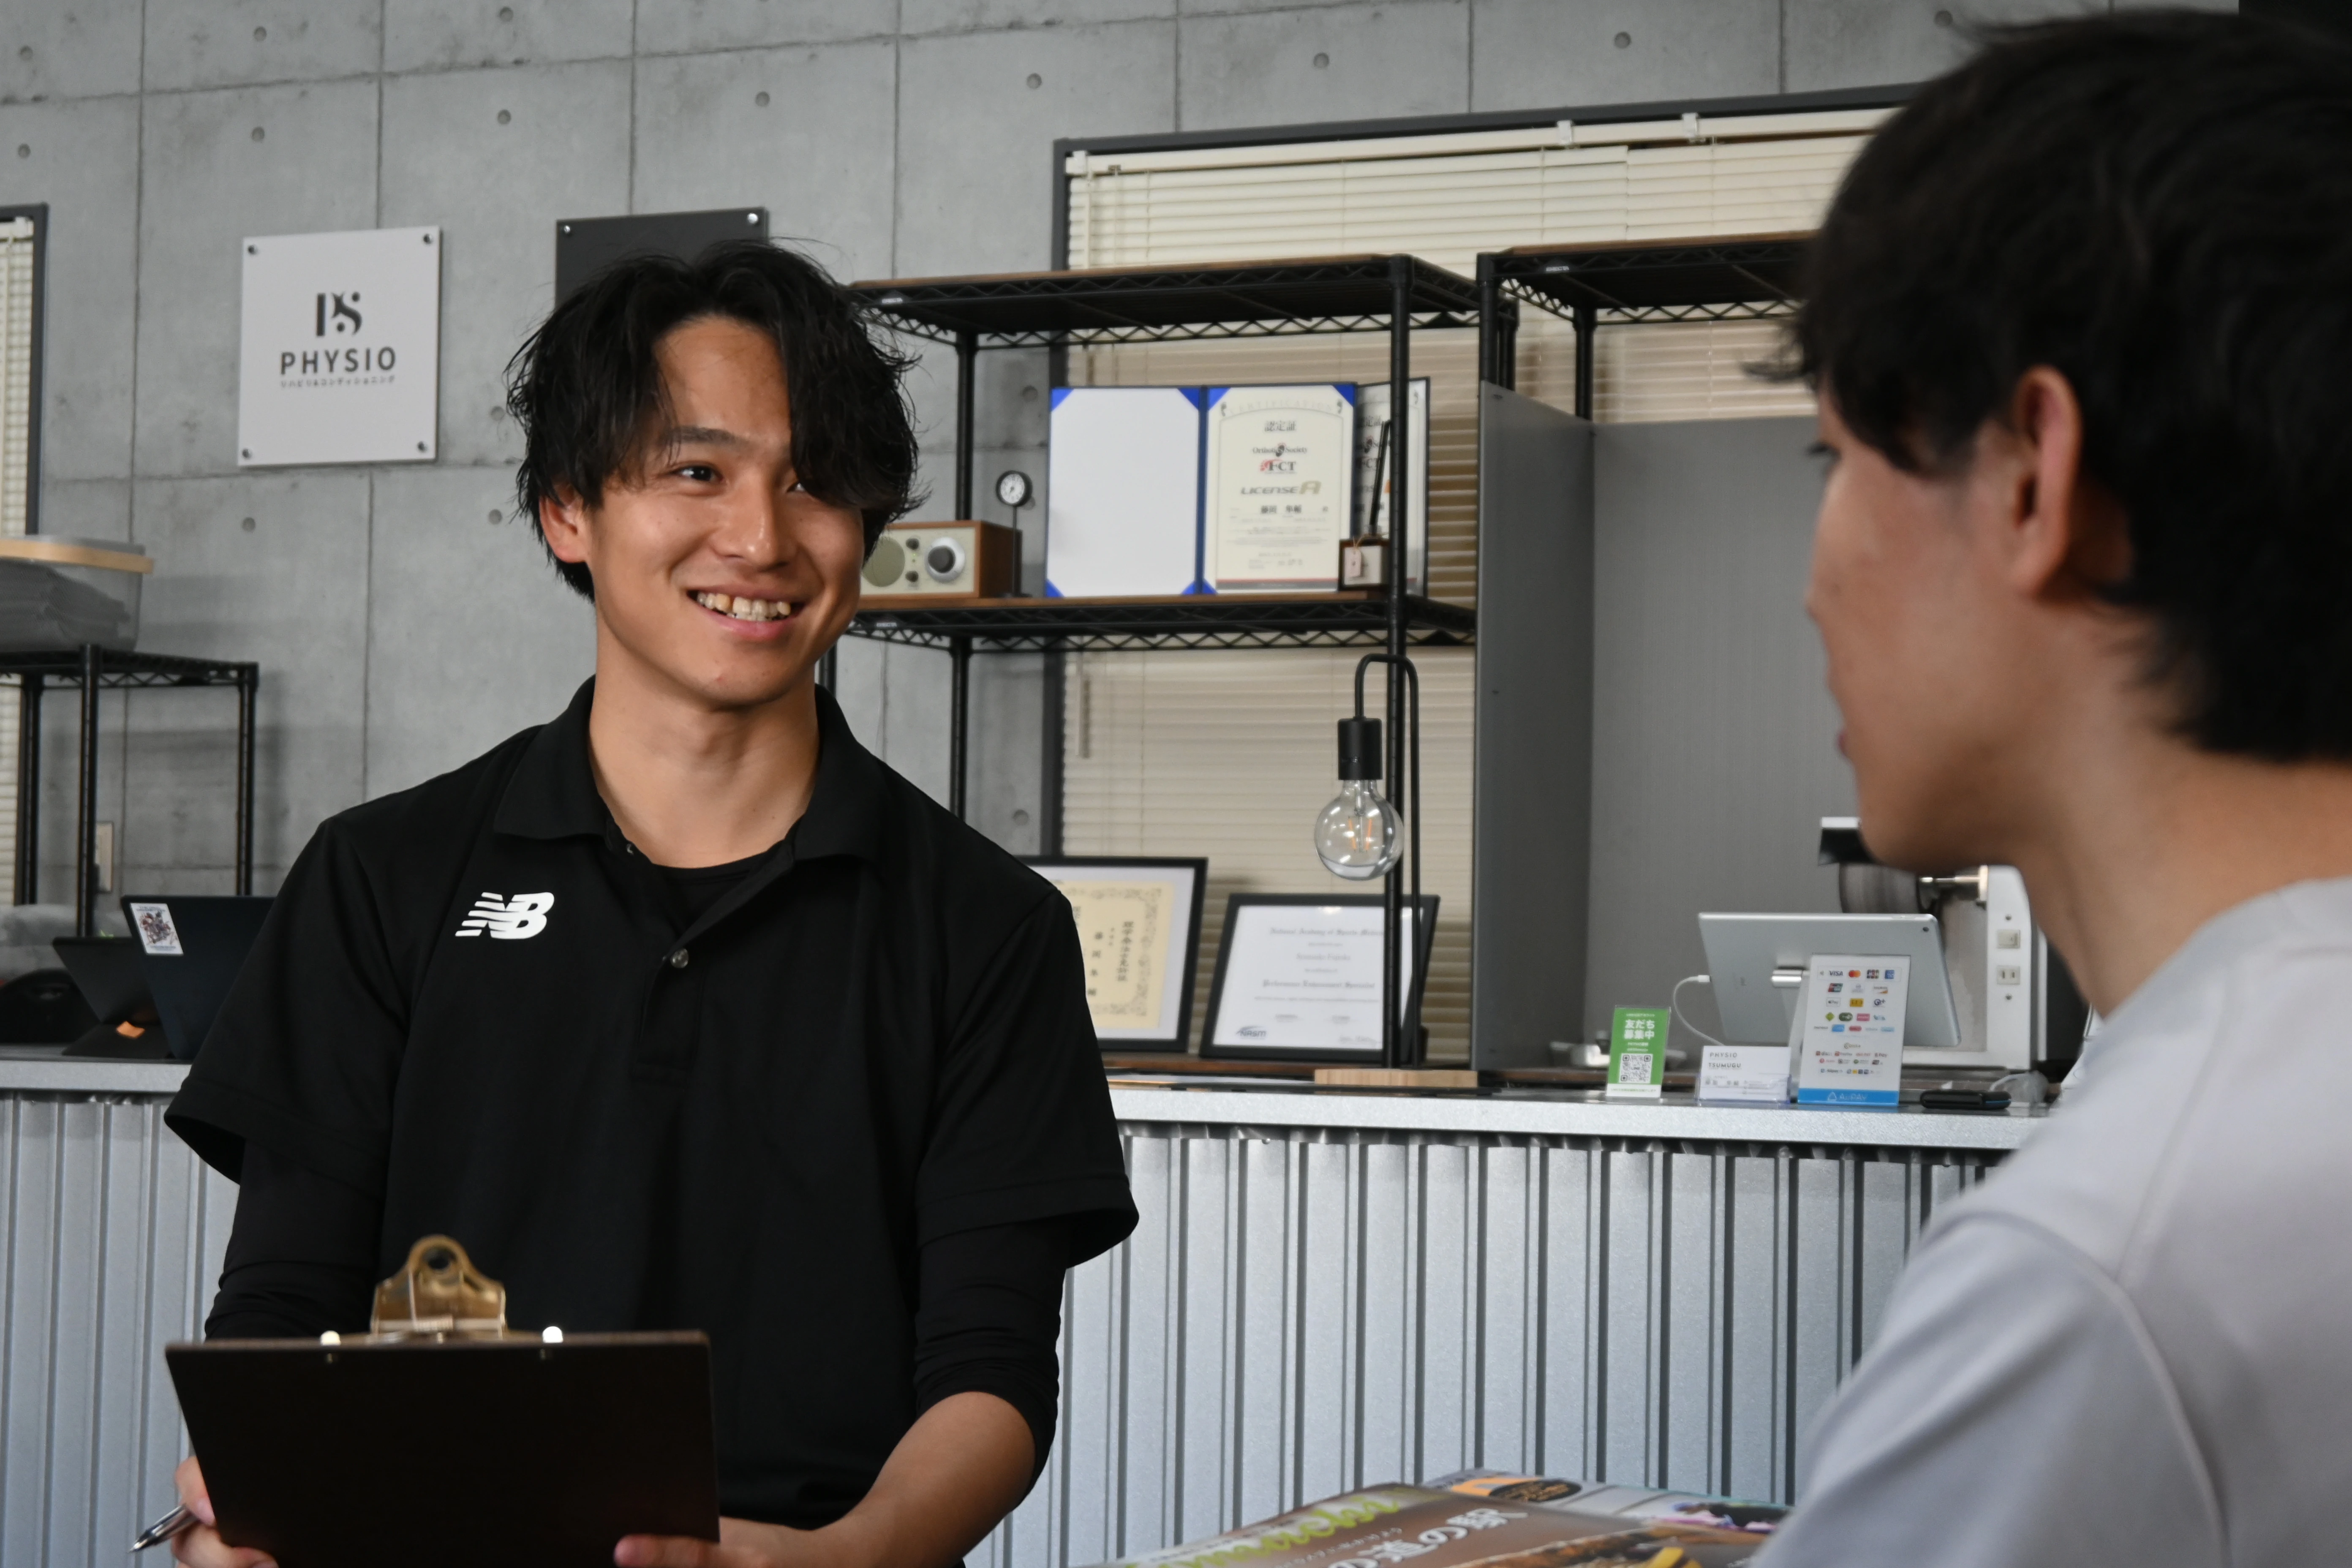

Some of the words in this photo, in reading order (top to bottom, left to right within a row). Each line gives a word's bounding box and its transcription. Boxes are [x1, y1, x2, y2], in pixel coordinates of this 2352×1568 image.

[280, 346, 396, 375] PHYSIO
[1625, 1019, 1655, 1029] 友だち
